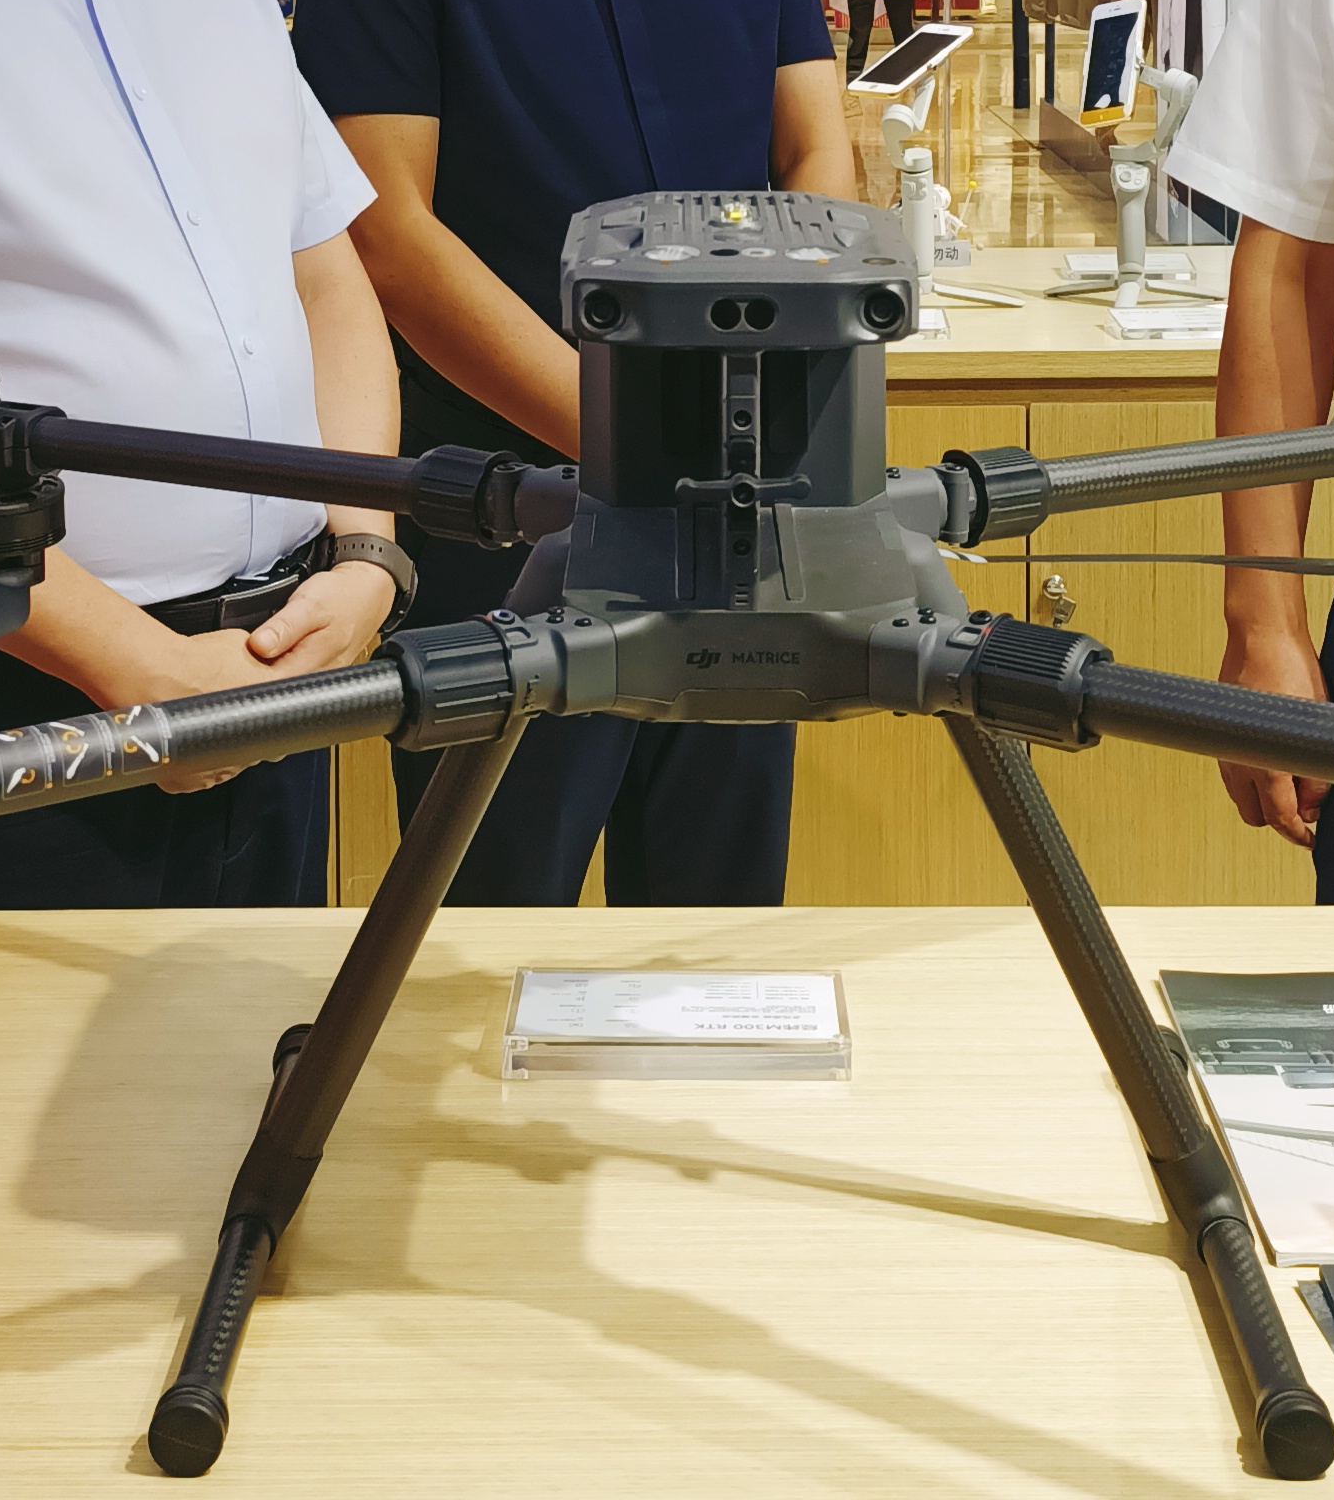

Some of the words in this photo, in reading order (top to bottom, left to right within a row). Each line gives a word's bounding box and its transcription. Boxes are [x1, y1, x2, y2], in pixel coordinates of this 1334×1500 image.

[934, 246, 959, 261] 勿动
[732, 651, 800, 665] MATRICE
[694, 1023, 728, 1031] RTK
